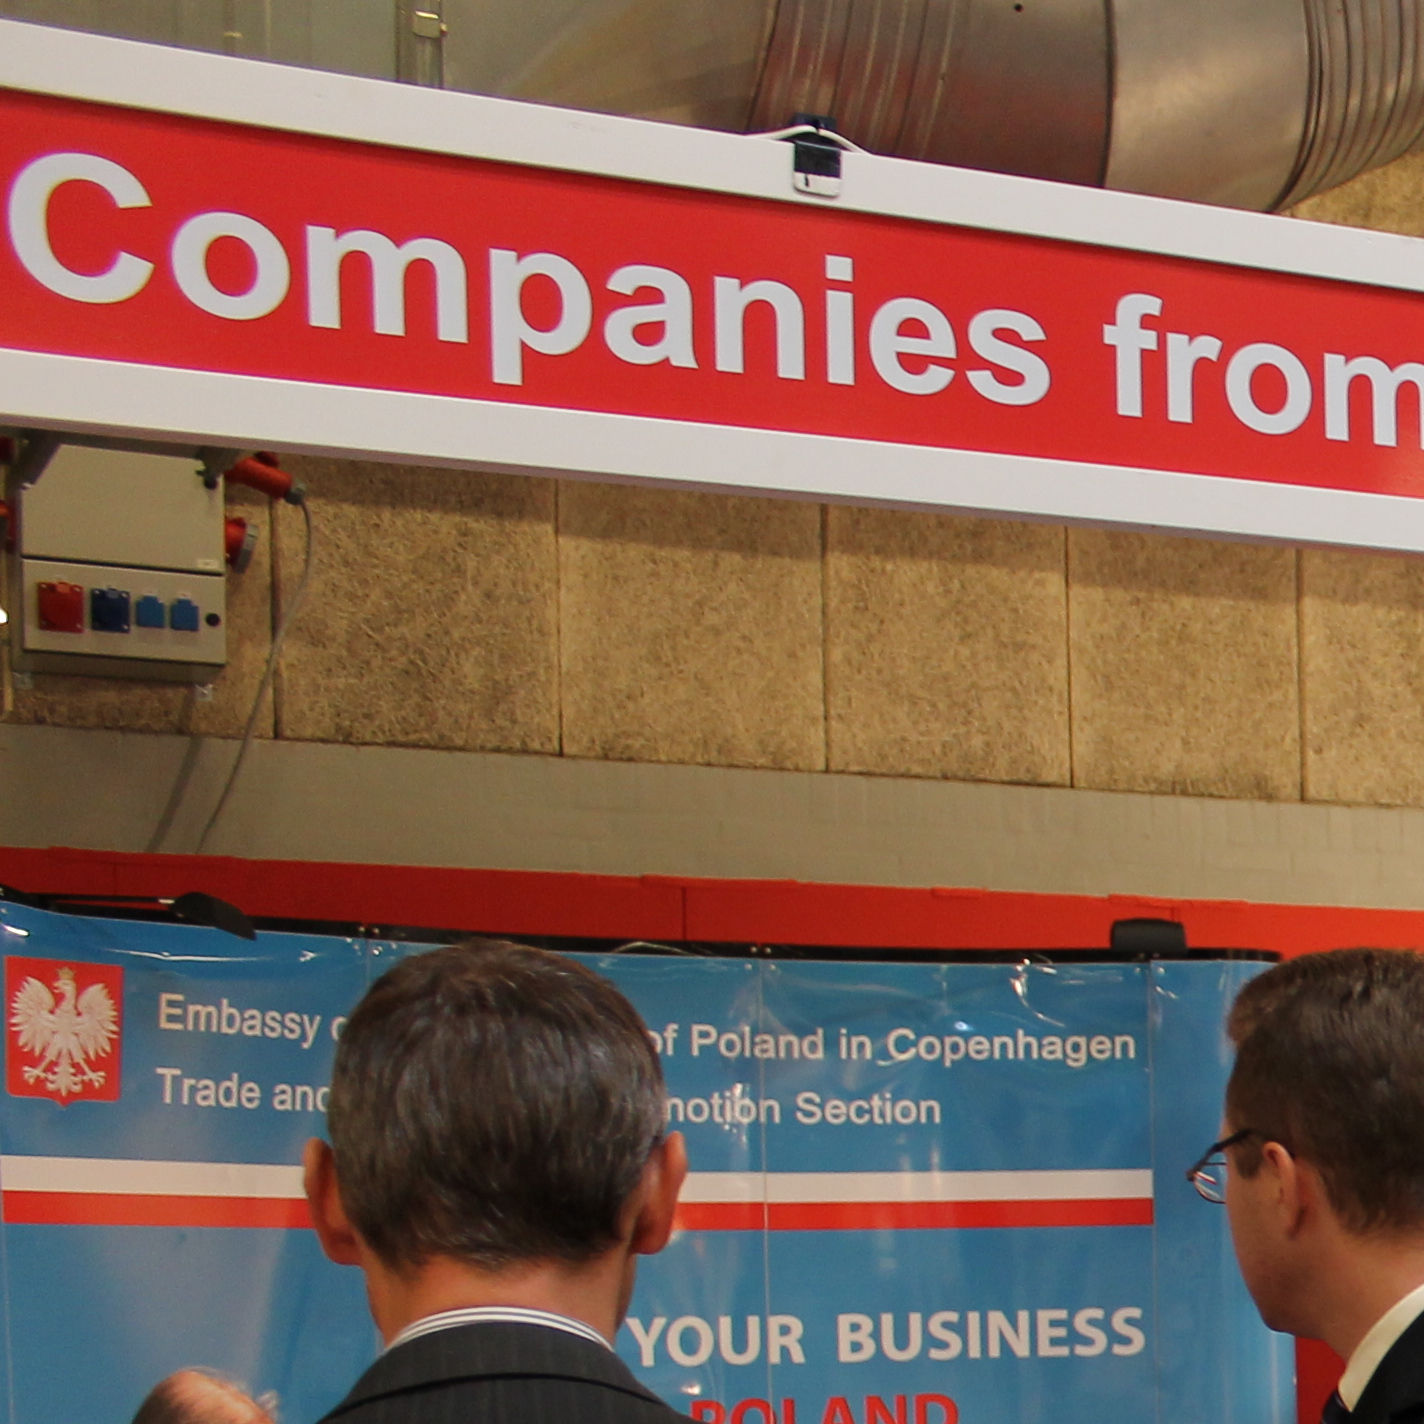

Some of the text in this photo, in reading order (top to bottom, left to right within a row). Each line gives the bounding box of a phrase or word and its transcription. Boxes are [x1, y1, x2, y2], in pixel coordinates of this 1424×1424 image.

[7, 152, 1052, 407] Companies
[158, 992, 322, 1049] Embassy
[690, 1023, 825, 1060] Poland
[839, 1028, 873, 1061] in
[886, 1027, 1136, 1068] Copenhagen
[155, 1067, 262, 1110] Trade
[795, 1091, 941, 1125] Section
[624, 1305, 1146, 1367] YOUR BUSINESS
